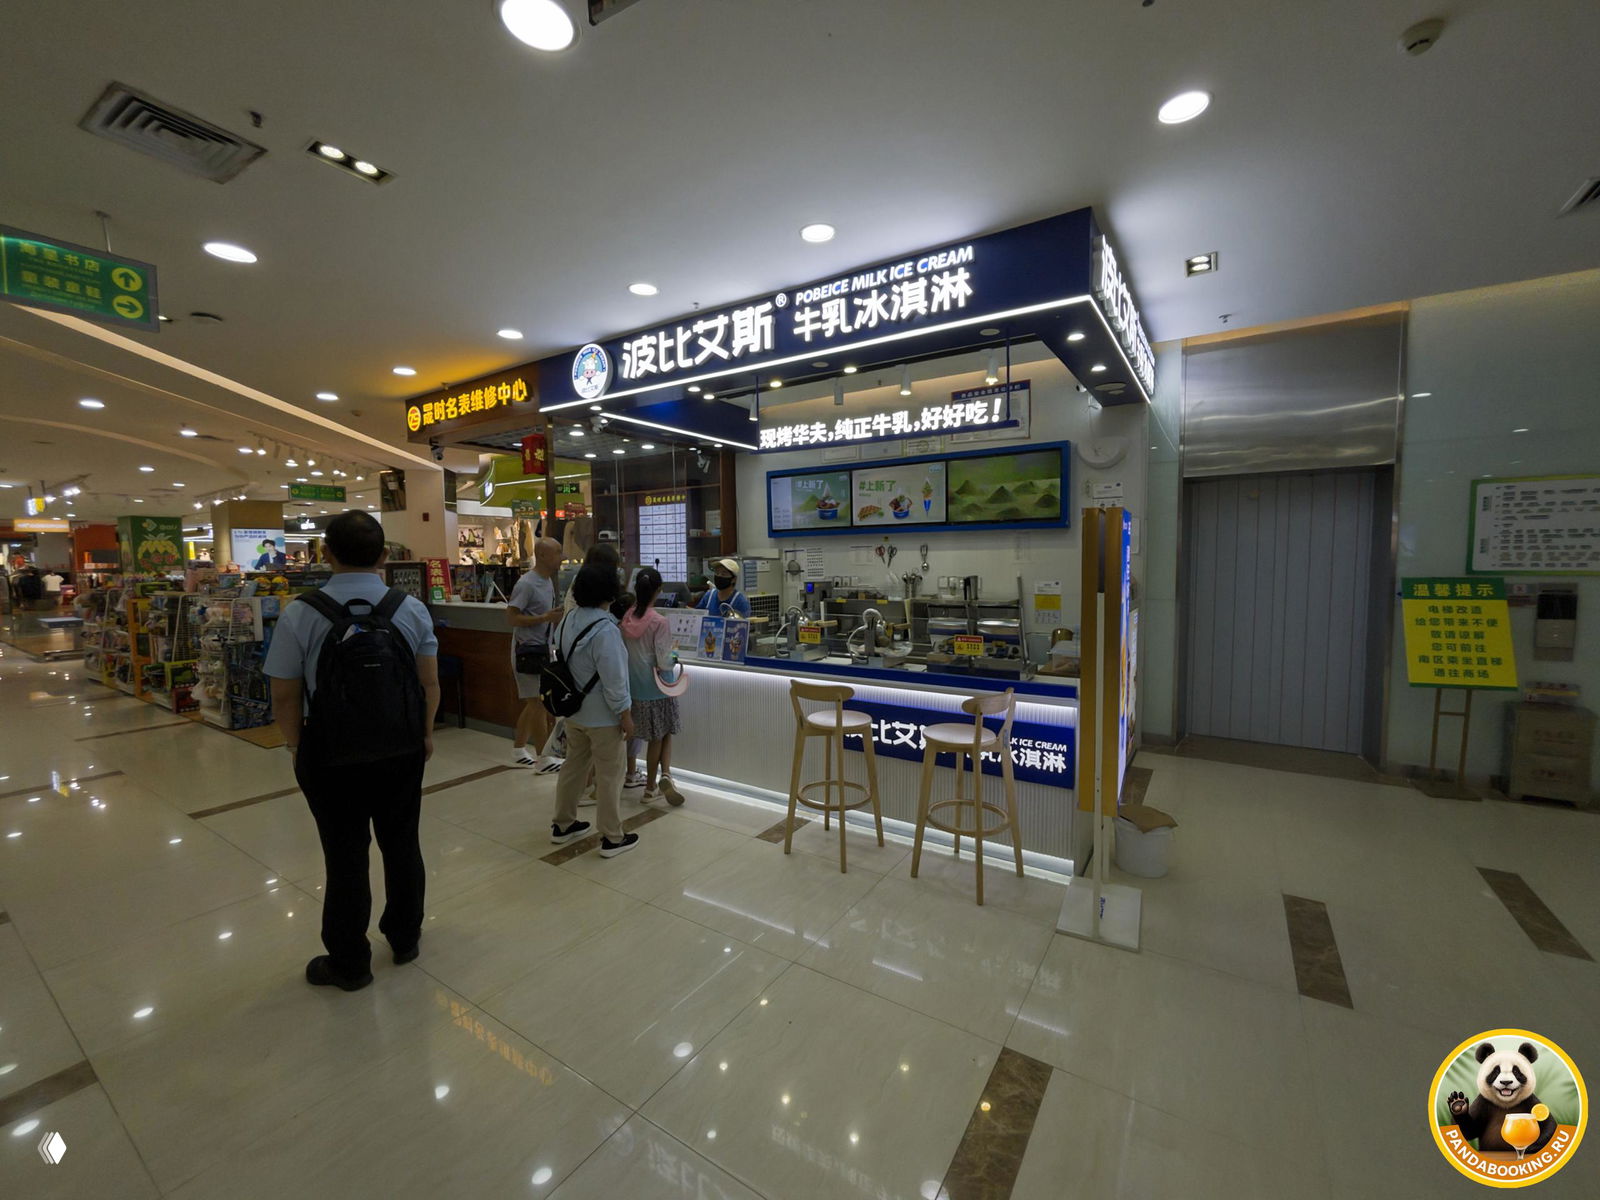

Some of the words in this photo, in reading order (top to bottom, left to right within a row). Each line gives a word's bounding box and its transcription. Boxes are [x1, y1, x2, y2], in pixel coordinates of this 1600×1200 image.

[792, 267, 974, 342] 牛乳冰淇淋
[795, 278, 849, 306] POBEICE
[851, 269, 888, 292] MILK
[889, 261, 913, 281] ICE
[916, 245, 973, 273] CREAM
[622, 301, 774, 379] 波比艾斯
[1412, 583, 1495, 597] 温馨提示
[1019, 738, 1033, 748] ICE
[1034, 741, 1067, 753] CREAM
